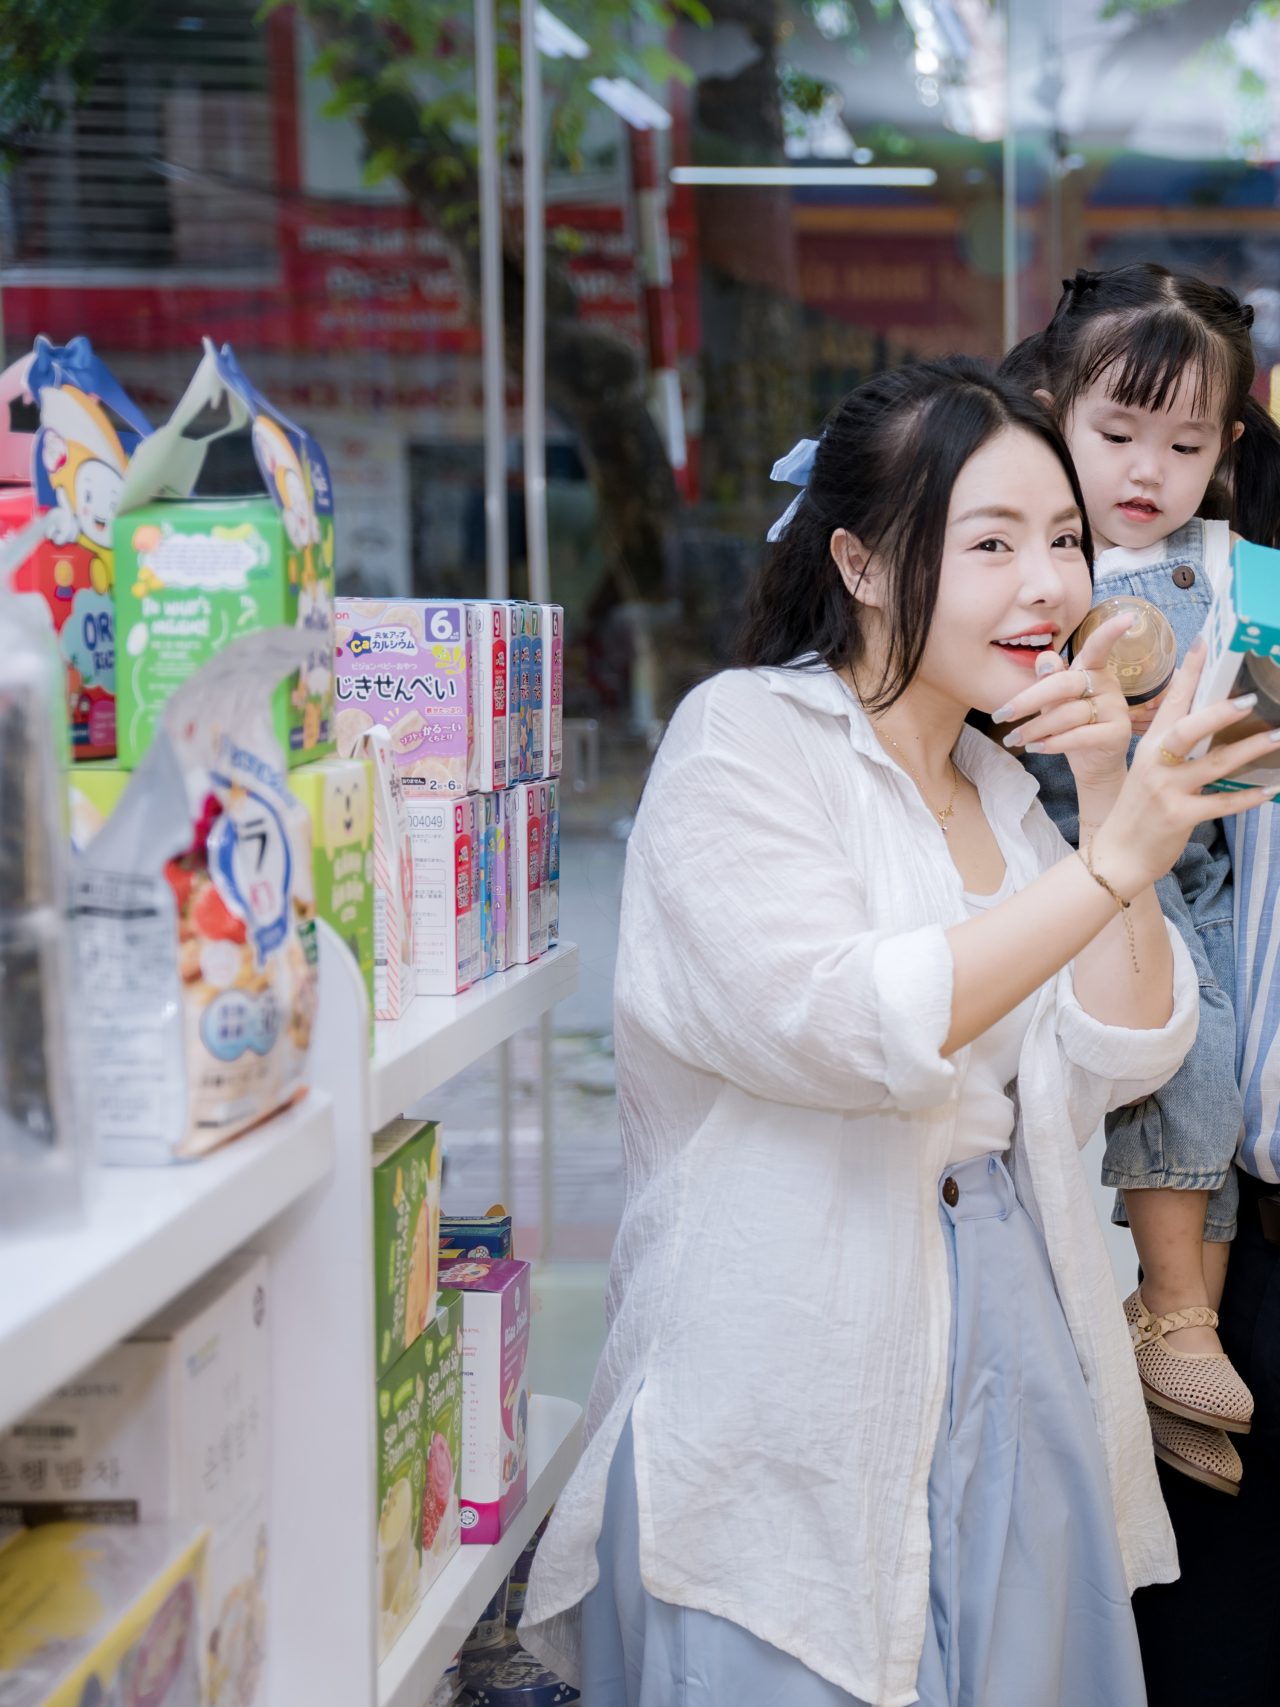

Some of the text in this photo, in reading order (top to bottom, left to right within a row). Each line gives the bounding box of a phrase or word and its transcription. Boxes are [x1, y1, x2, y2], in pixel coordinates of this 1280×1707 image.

[431, 610, 453, 640] 6
[336, 674, 456, 701] じきせんべい
